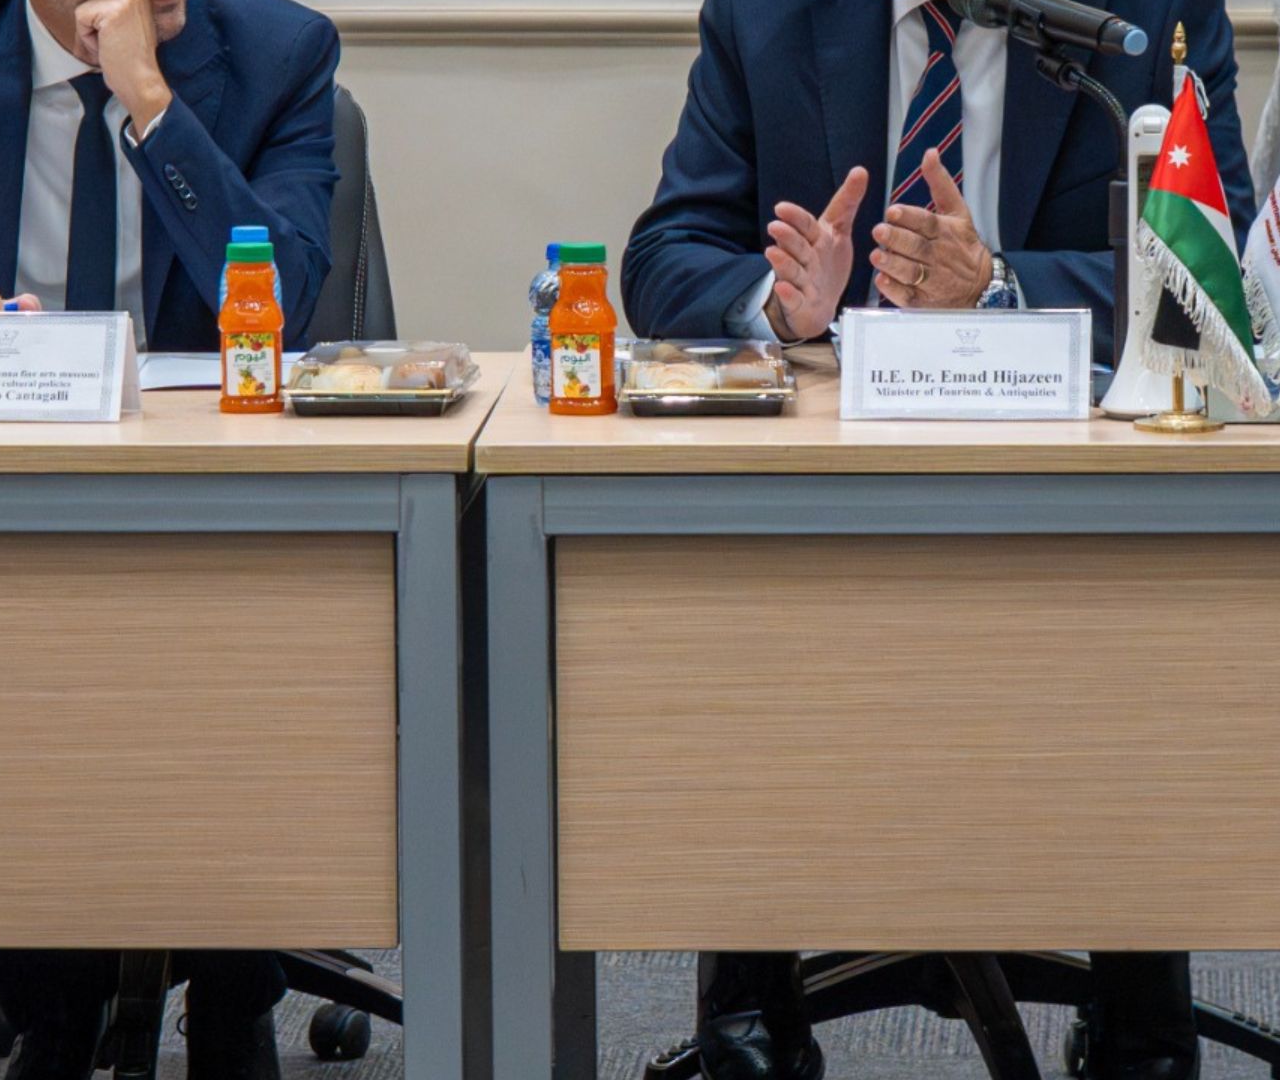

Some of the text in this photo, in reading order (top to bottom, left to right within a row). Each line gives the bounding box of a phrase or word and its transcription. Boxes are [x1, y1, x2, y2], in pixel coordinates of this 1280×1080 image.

[1, 379, 36, 387] cultural
[870, 369, 1063, 386] H.E. Dr. Emad Hijazeen
[5, 389, 69, 402] Cantagalli
[876, 387, 1057, 399] Minister of Tourism & Antiquities
